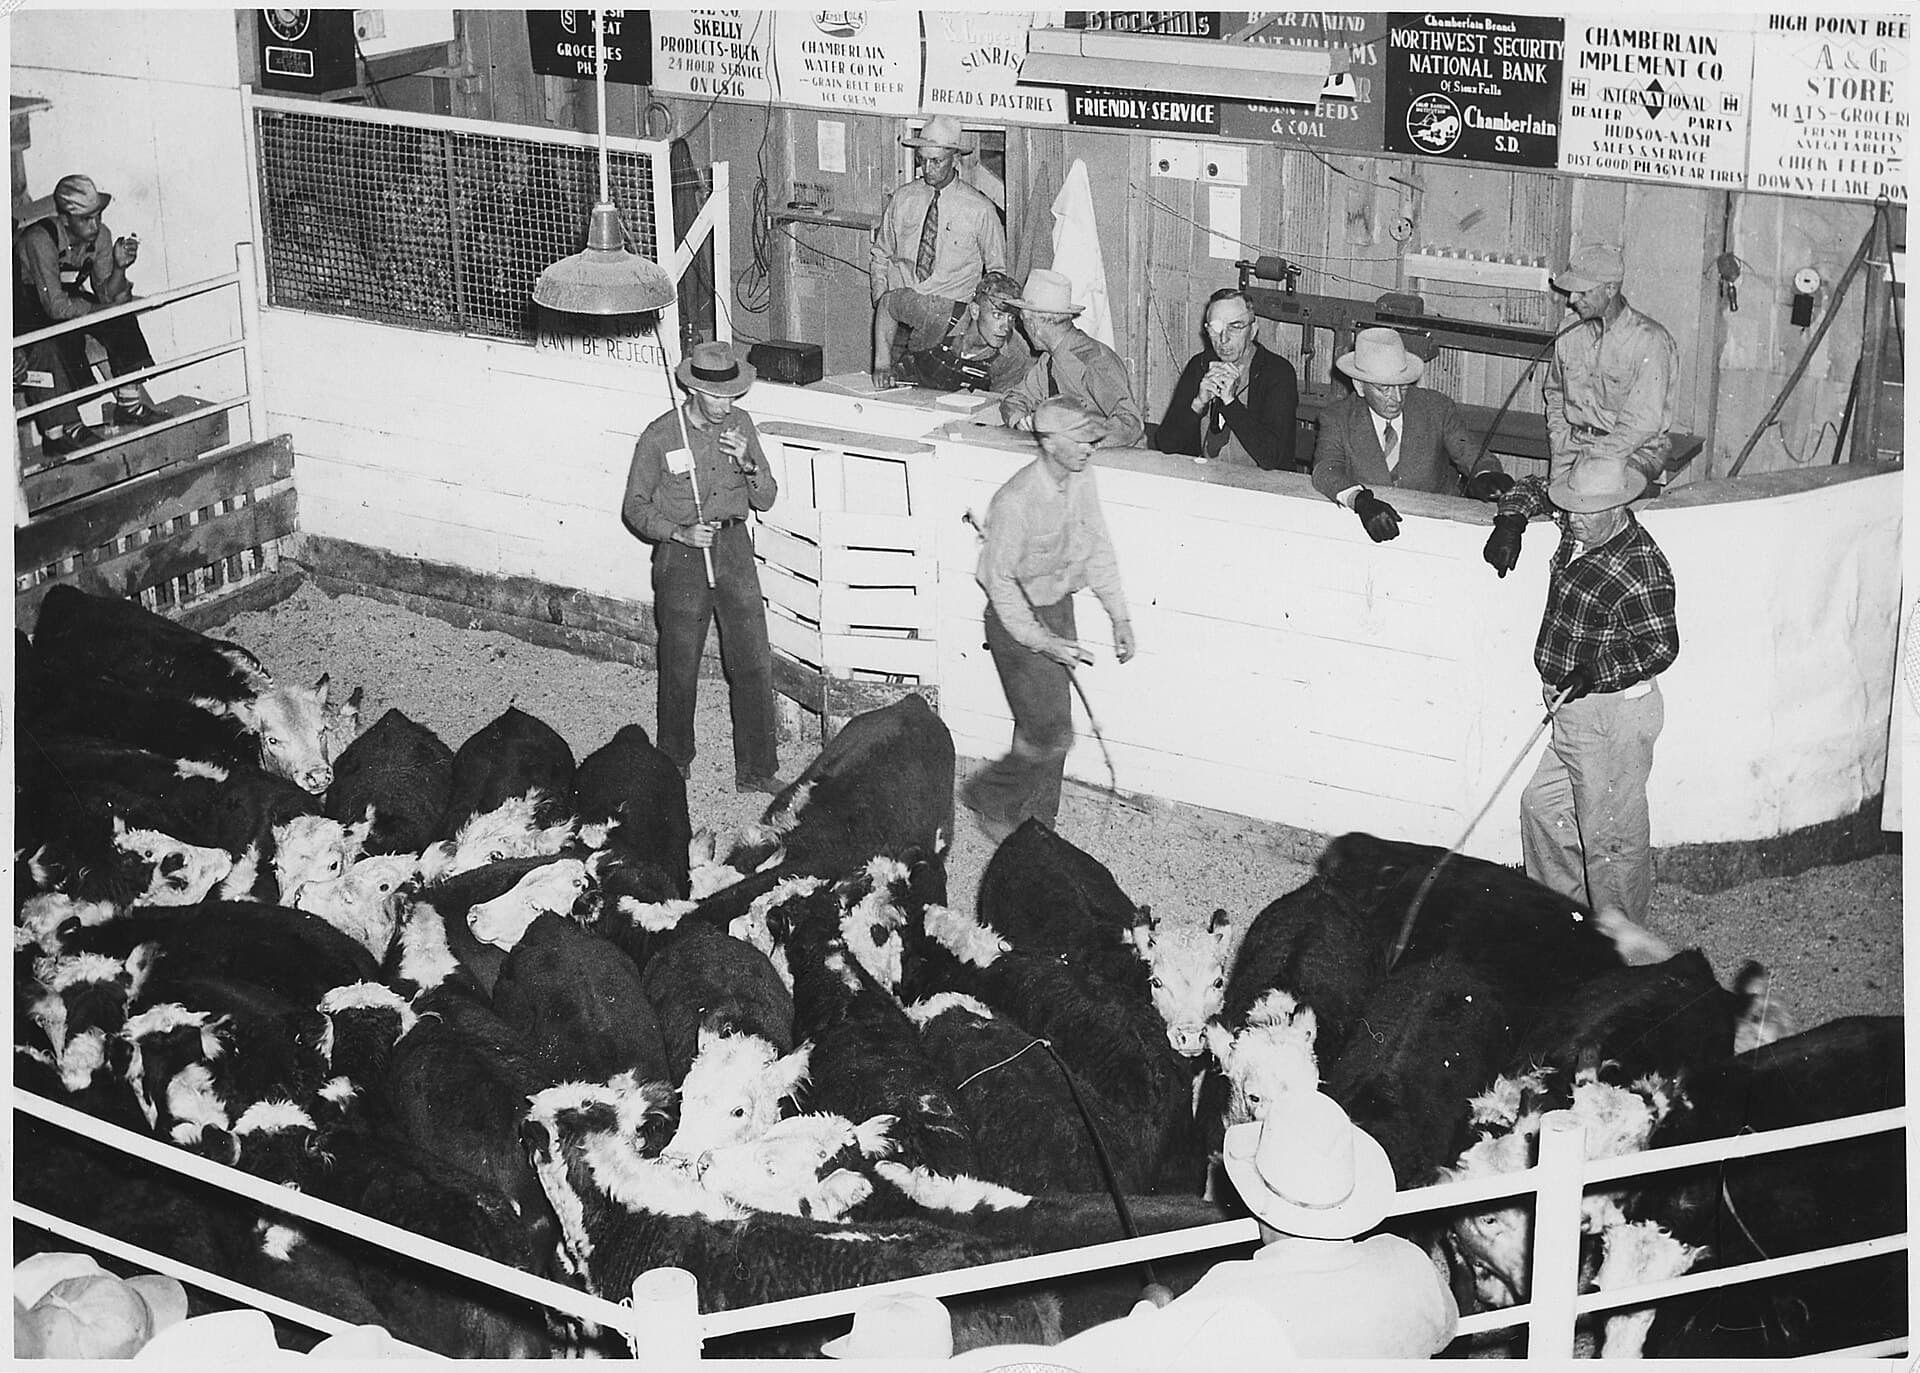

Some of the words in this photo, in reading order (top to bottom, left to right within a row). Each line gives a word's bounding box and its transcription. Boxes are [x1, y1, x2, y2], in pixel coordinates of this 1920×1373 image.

[588, 10, 624, 18] ESH
[1248, 11, 1297, 27] BR
[1300, 12, 1320, 28] IN
[1325, 14, 1366, 32] MIND
[1424, 14, 1484, 30] Chamberlain
[1485, 17, 1517, 33] Branch
[1769, 14, 1807, 31] HIGH
[1815, 17, 1869, 35] POINT
[693, 18, 742, 40] SKELLY
[557, 43, 622, 61] GROCEIES
[801, 41, 885, 59] CHAMBERLAIN
[1390, 28, 1488, 54] NORTHWEST
[1493, 36, 1565, 61] SECURITY
[1585, 27, 1718, 56] CHAMBERLAIN
[686, 58, 714, 74] HOUR
[721, 62, 764, 80] SERVICE
[804, 58, 845, 74] WATER
[850, 62, 864, 76] CO
[868, 64, 885, 77] INC
[1409, 54, 1493, 78] NATIONAL
[1502, 61, 1548, 84] BANK
[1580, 50, 1688, 78] IMPLEMENT
[1816, 44, 1834, 70] A
[1844, 50, 1860, 70] &
[1870, 47, 1887, 73] G
[690, 76, 707, 93] ON
[846, 79, 869, 91] BELT
[874, 82, 904, 93] BEER
[1440, 80, 1452, 93] Of
[1453, 80, 1478, 94] Sioux
[1478, 82, 1502, 96] Falls
[1807, 77, 1895, 104] STORE
[822, 92, 836, 102] ICE
[843, 94, 876, 107] CREAM
[931, 88, 973, 105] BREAD
[990, 93, 1053, 112] PASTRIES
[1603, 88, 1707, 112] INTERNATIONAL
[1271, 118, 1283, 135] &
[1288, 120, 1327, 138] COAL
[1464, 105, 1557, 136] Chamberlain
[1571, 105, 1622, 121] DEALER
[1688, 116, 1733, 132] PARTS
[1494, 135, 1520, 153] S.D.
[1605, 124, 1710, 148] HUDSON-NASH
[1803, 126, 1847, 138] FRESH
[1855, 130, 1903, 143] FRUITS
[1593, 140, 1634, 156] SALES
[1652, 147, 1707, 163] SERVICE
[1568, 153, 1592, 166] DIST
[1596, 156, 1629, 170] GOOD
[1671, 165, 1705, 179] YEAR
[1710, 169, 1743, 182] TIRES
[1778, 156, 1828, 171] CHICK
[1838, 158, 1884, 175] FEED
[1757, 173, 1815, 191] DOWNY
[1821, 178, 1869, 195] FLAKE
[582, 335, 600, 356] BE
